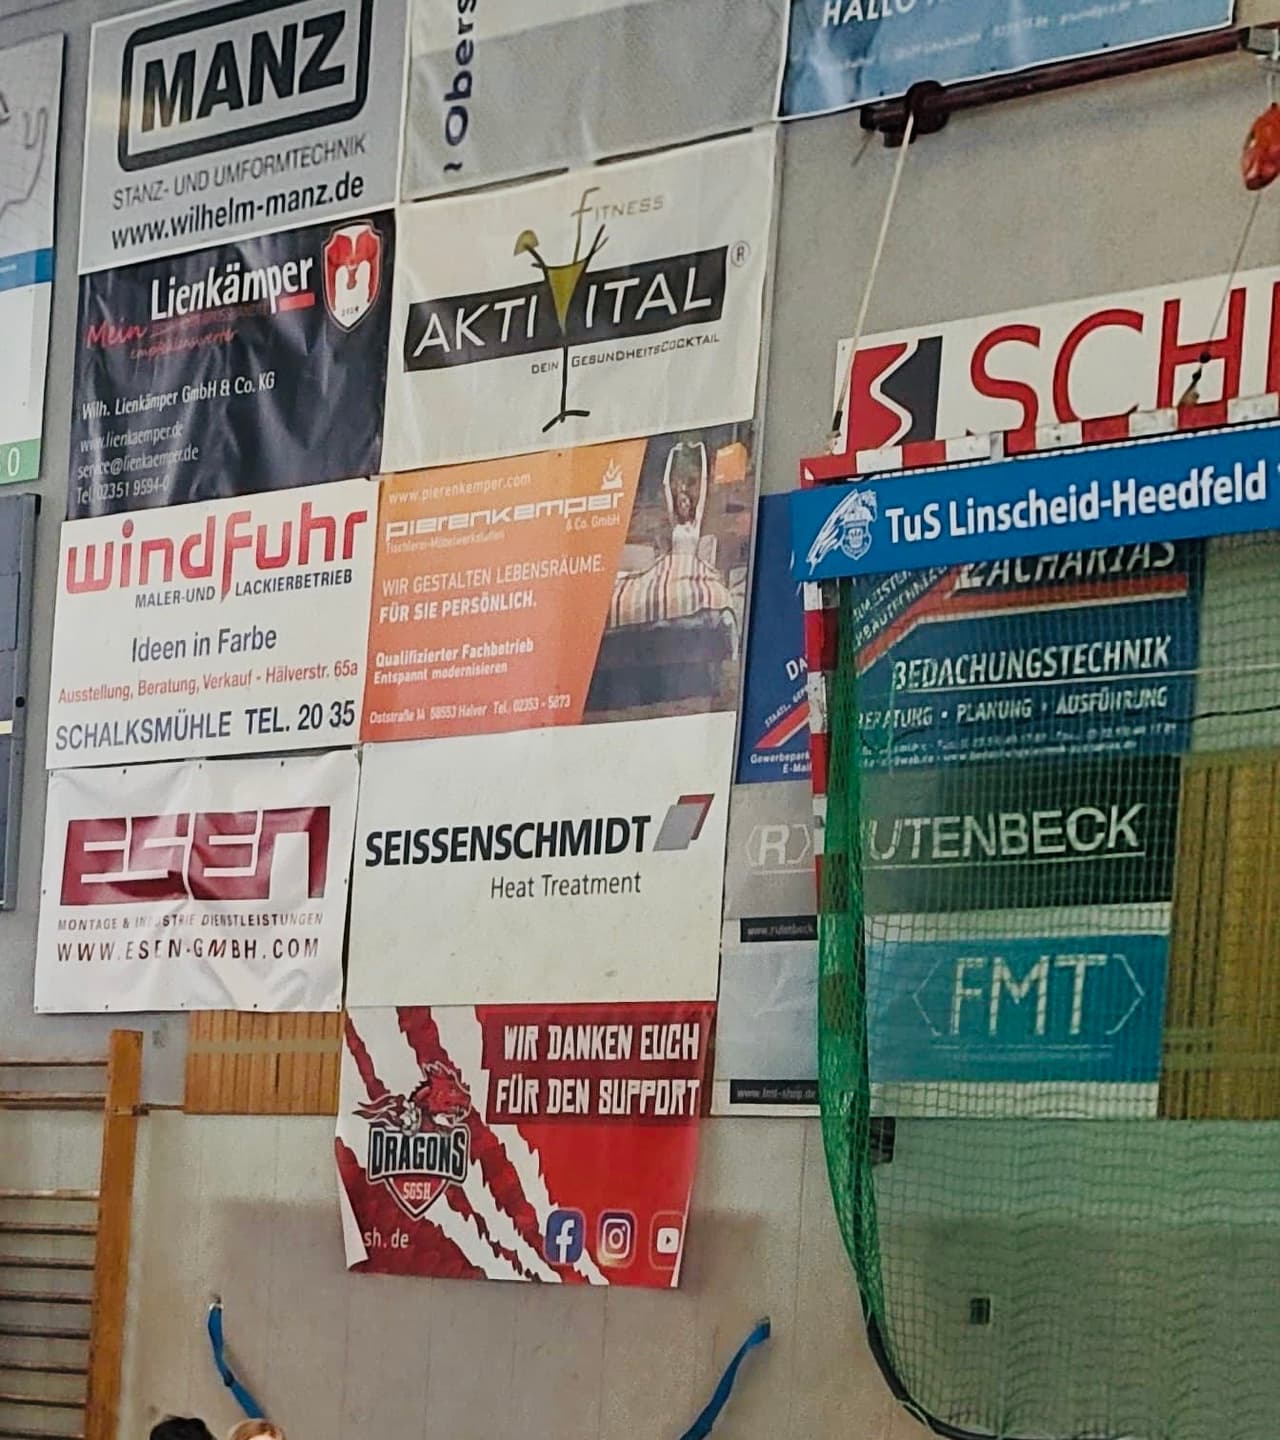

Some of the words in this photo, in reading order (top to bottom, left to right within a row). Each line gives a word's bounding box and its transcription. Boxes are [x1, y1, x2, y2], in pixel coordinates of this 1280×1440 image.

[141, 9, 346, 133] MANZ
[112, 179, 169, 211] STANZ-
[173, 171, 210, 197] UND
[214, 133, 367, 188] UMFORMTECHNIK
[111, 171, 365, 250] www.wilhelm-manz.de
[150, 257, 313, 322] Lienkämper
[531, 360, 559, 375] DEIN
[81, 400, 111, 421] Wilh.
[115, 390, 178, 422] Lienkämper
[182, 379, 217, 404] GmbH
[235, 375, 256, 395] Co.
[259, 371, 276, 390] KG
[7, 447, 20, 477] 0
[388, 471, 532, 505] www.pierenkemper.com
[886, 502, 941, 544] TuS
[949, 458, 1267, 538] Linscheid-Heedfeld
[385, 492, 625, 543] pierenkemper
[590, 512, 621, 527] GmbH
[65, 501, 369, 602] windfuhr
[234, 568, 353, 598] LACKIERBETRIEB
[381, 578, 409, 598] WIR
[413, 566, 491, 594] GESTALTEN
[496, 553, 606, 585] LEBENSRÄUME.
[379, 601, 409, 624] FÜR
[413, 598, 438, 620] SIE
[441, 589, 537, 617] PERSÖNLICH.
[131, 635, 187, 663] Ideen
[192, 631, 211, 658] in
[218, 625, 277, 657] Farbe
[375, 647, 458, 669] Qualifizierter
[461, 637, 535, 660] Fachbetrieb
[893, 635, 1172, 690] BEDACHUNGSTECHNIK
[57, 681, 134, 705] Ausstellung,
[137, 673, 200, 699] Beratung,
[203, 669, 252, 691] Verkauf
[333, 659, 359, 678] 65a
[373, 669, 428, 686] Entspannt
[431, 660, 509, 680] modernisieren
[54, 708, 233, 751] SCHALKSMÜHLE
[244, 706, 291, 735] TEL.
[297, 703, 324, 731] 20
[328, 700, 356, 728] 35
[956, 699, 1033, 723] PLANUNG
[364, 814, 652, 868] SEISSENSCHMIDT
[864, 801, 1147, 863] UTENBECK
[490, 875, 536, 900] Heat
[541, 871, 642, 898] Treatment
[57, 917, 118, 932] MONTAGE
[201, 911, 325, 928] DIENSTLEISTUNGEN
[949, 953, 1108, 1037] FMT
[504, 1024, 539, 1061] WIR
[547, 1024, 633, 1062] DANKEN
[640, 1023, 700, 1060] EUCH
[495, 1074, 539, 1115] FÜR
[546, 1078, 590, 1115] DEN
[598, 1078, 701, 1117] SUPPORT
[371, 1126, 468, 1176] DRAGONS
